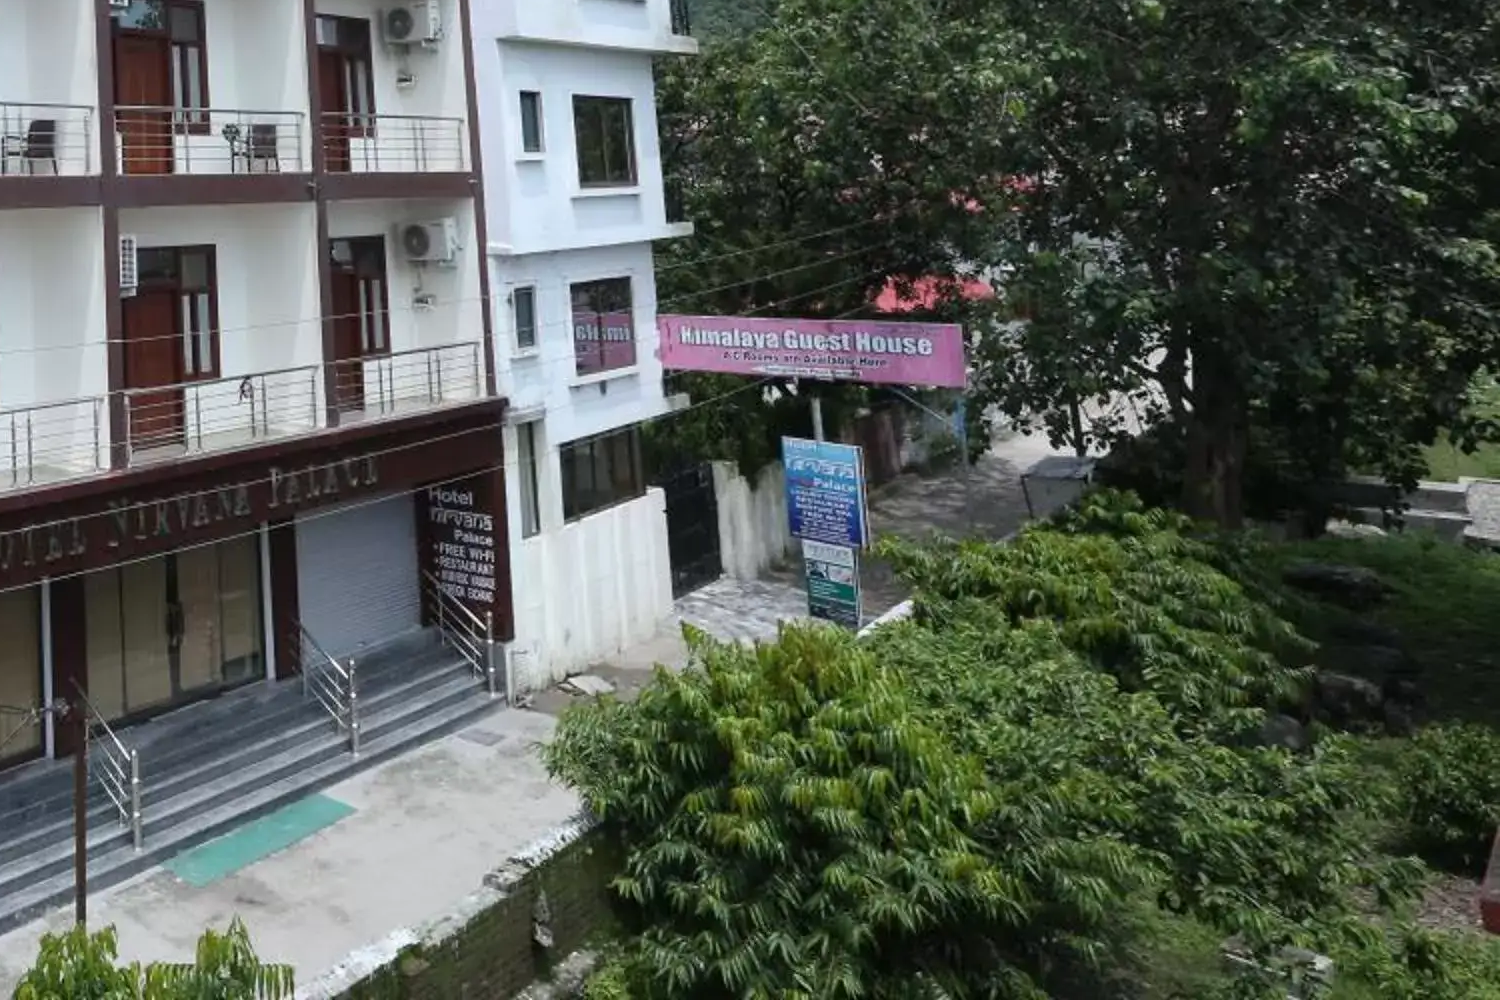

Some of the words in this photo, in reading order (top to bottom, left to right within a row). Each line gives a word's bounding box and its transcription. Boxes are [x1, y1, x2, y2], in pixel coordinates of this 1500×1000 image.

[680, 325, 779, 350] Himalaya
[783, 328, 851, 352] Guest
[855, 331, 933, 355] House
[429, 485, 473, 506] Hotel
[453, 529, 493, 547] Palace
[439, 541, 466, 558] FREE
